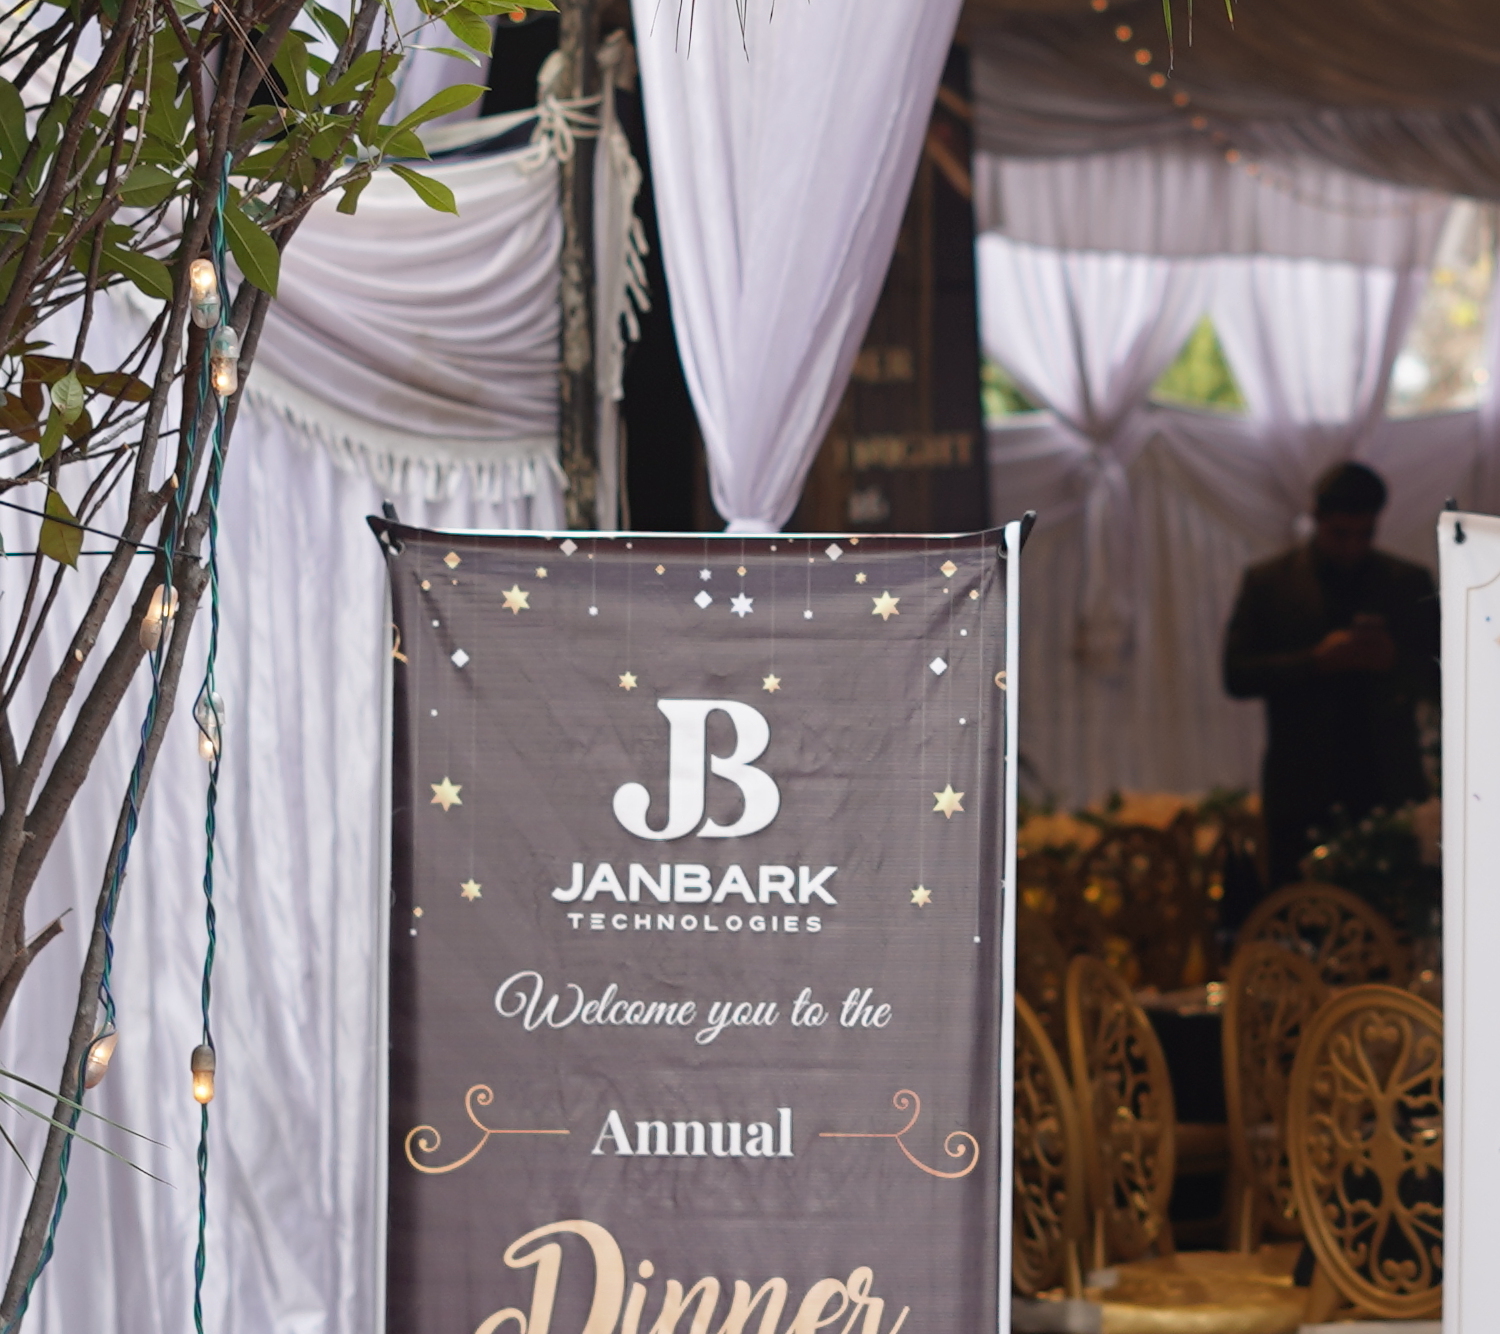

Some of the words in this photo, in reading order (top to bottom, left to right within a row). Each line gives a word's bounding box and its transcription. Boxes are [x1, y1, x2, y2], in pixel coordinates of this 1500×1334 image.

[613, 699, 780, 841] JB
[551, 862, 838, 905] JANBARK
[568, 913, 822, 933] TECHNOLOGIES
[495, 972, 696, 1032] Welcome
[698, 998, 780, 1045] you
[791, 988, 827, 1028] to
[840, 988, 893, 1028] the
[592, 1108, 794, 1157] Annual
